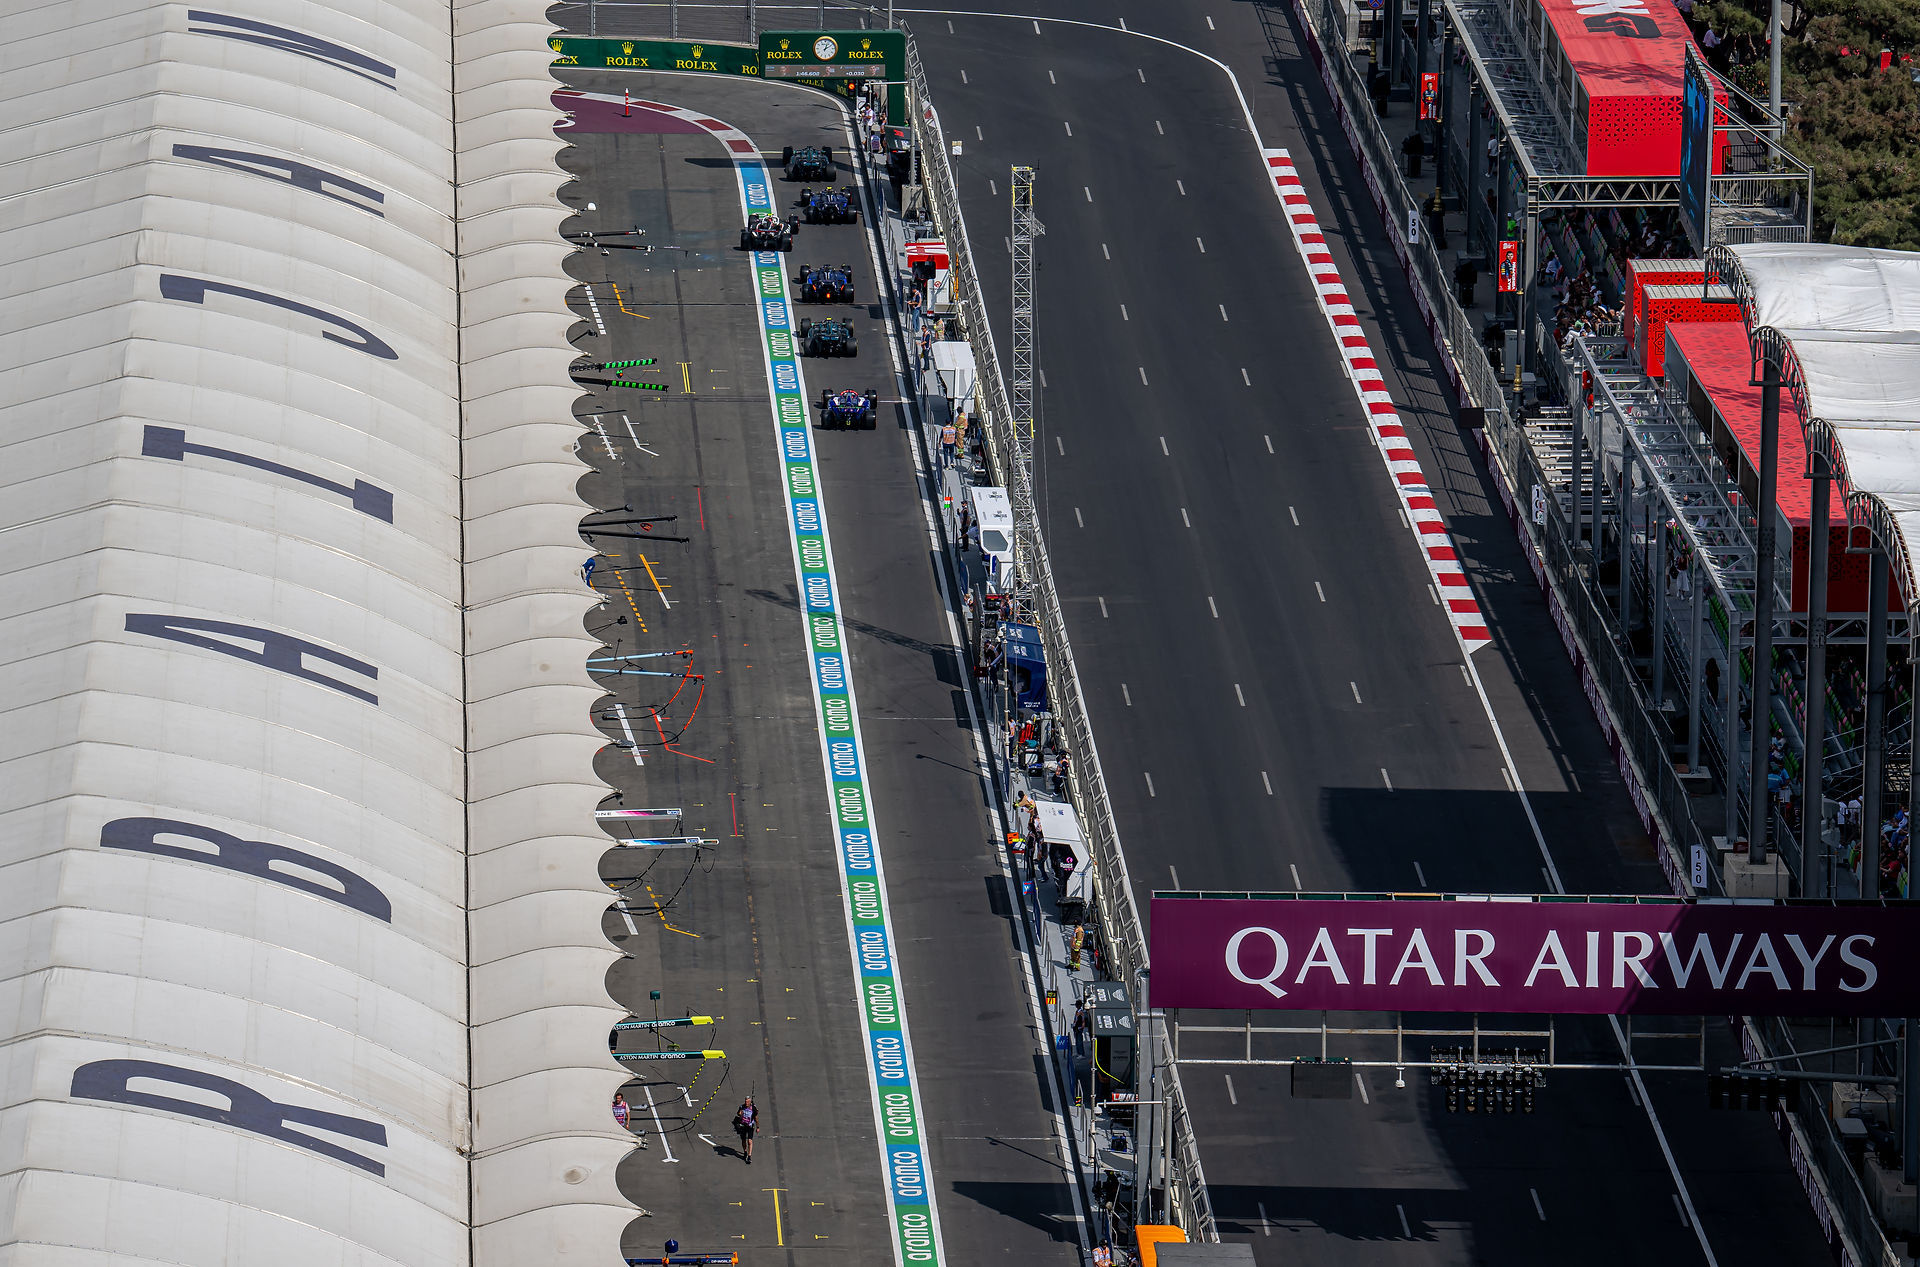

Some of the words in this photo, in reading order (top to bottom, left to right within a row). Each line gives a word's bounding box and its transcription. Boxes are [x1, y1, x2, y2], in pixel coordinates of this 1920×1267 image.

[606, 56, 649, 67] ROLEX
[676, 59, 718, 71] ROLEX
[767, 51, 803, 59] ROLEX
[848, 51, 884, 59] ROLEX
[1411, 218, 1417, 236] 50
[761, 271, 781, 294] aramco
[766, 302, 786, 325] aramco
[770, 333, 791, 357] aramco
[776, 365, 796, 389] aramco
[781, 398, 801, 423] aramco
[786, 432, 806, 457] aramco
[790, 467, 812, 494] aramco
[796, 503, 818, 530] aramco
[801, 540, 824, 567] aramco
[808, 578, 830, 607] aramco
[813, 618, 837, 647] aramco
[819, 657, 843, 688] aramco
[826, 699, 849, 731] aramco
[832, 743, 856, 775] aramco
[838, 788, 864, 822] aramco
[846, 834, 871, 869] aramco
[853, 882, 879, 918] aramco
[860, 932, 887, 970] aramco
[1225, 926, 1501, 998] QATAR
[1524, 929, 1879, 993] AIRWAYS
[868, 984, 895, 1023] aramco
[876, 1038, 904, 1078] aramco
[885, 1094, 913, 1136] aramco
[893, 1152, 922, 1196] aramco
[902, 1214, 932, 1260] aramco
